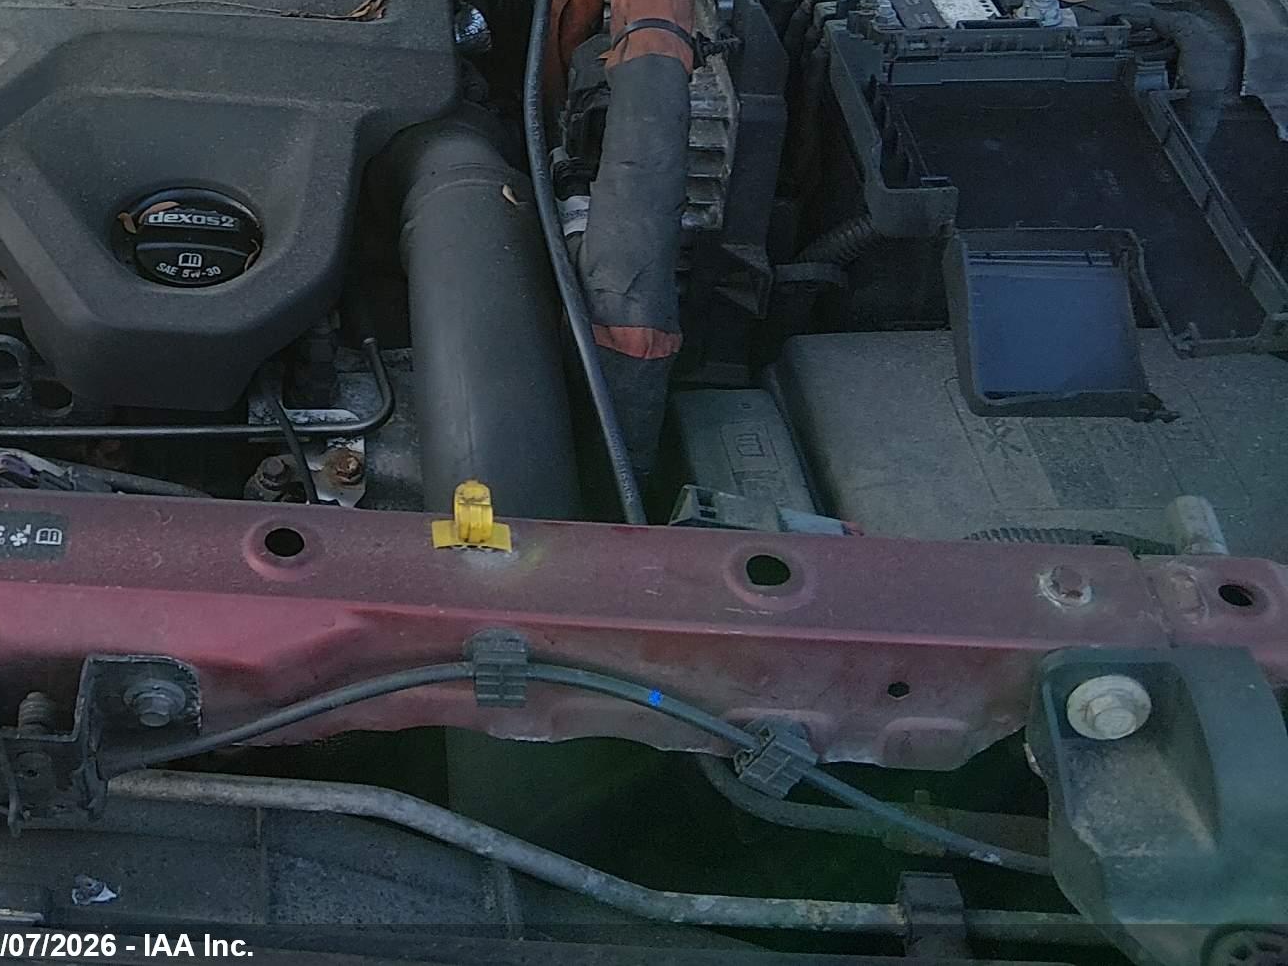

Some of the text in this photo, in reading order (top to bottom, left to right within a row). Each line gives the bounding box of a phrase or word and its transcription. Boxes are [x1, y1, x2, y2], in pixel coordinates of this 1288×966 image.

[148, 211, 235, 227] dexos2
[156, 262, 221, 278] SAE 5W-30
